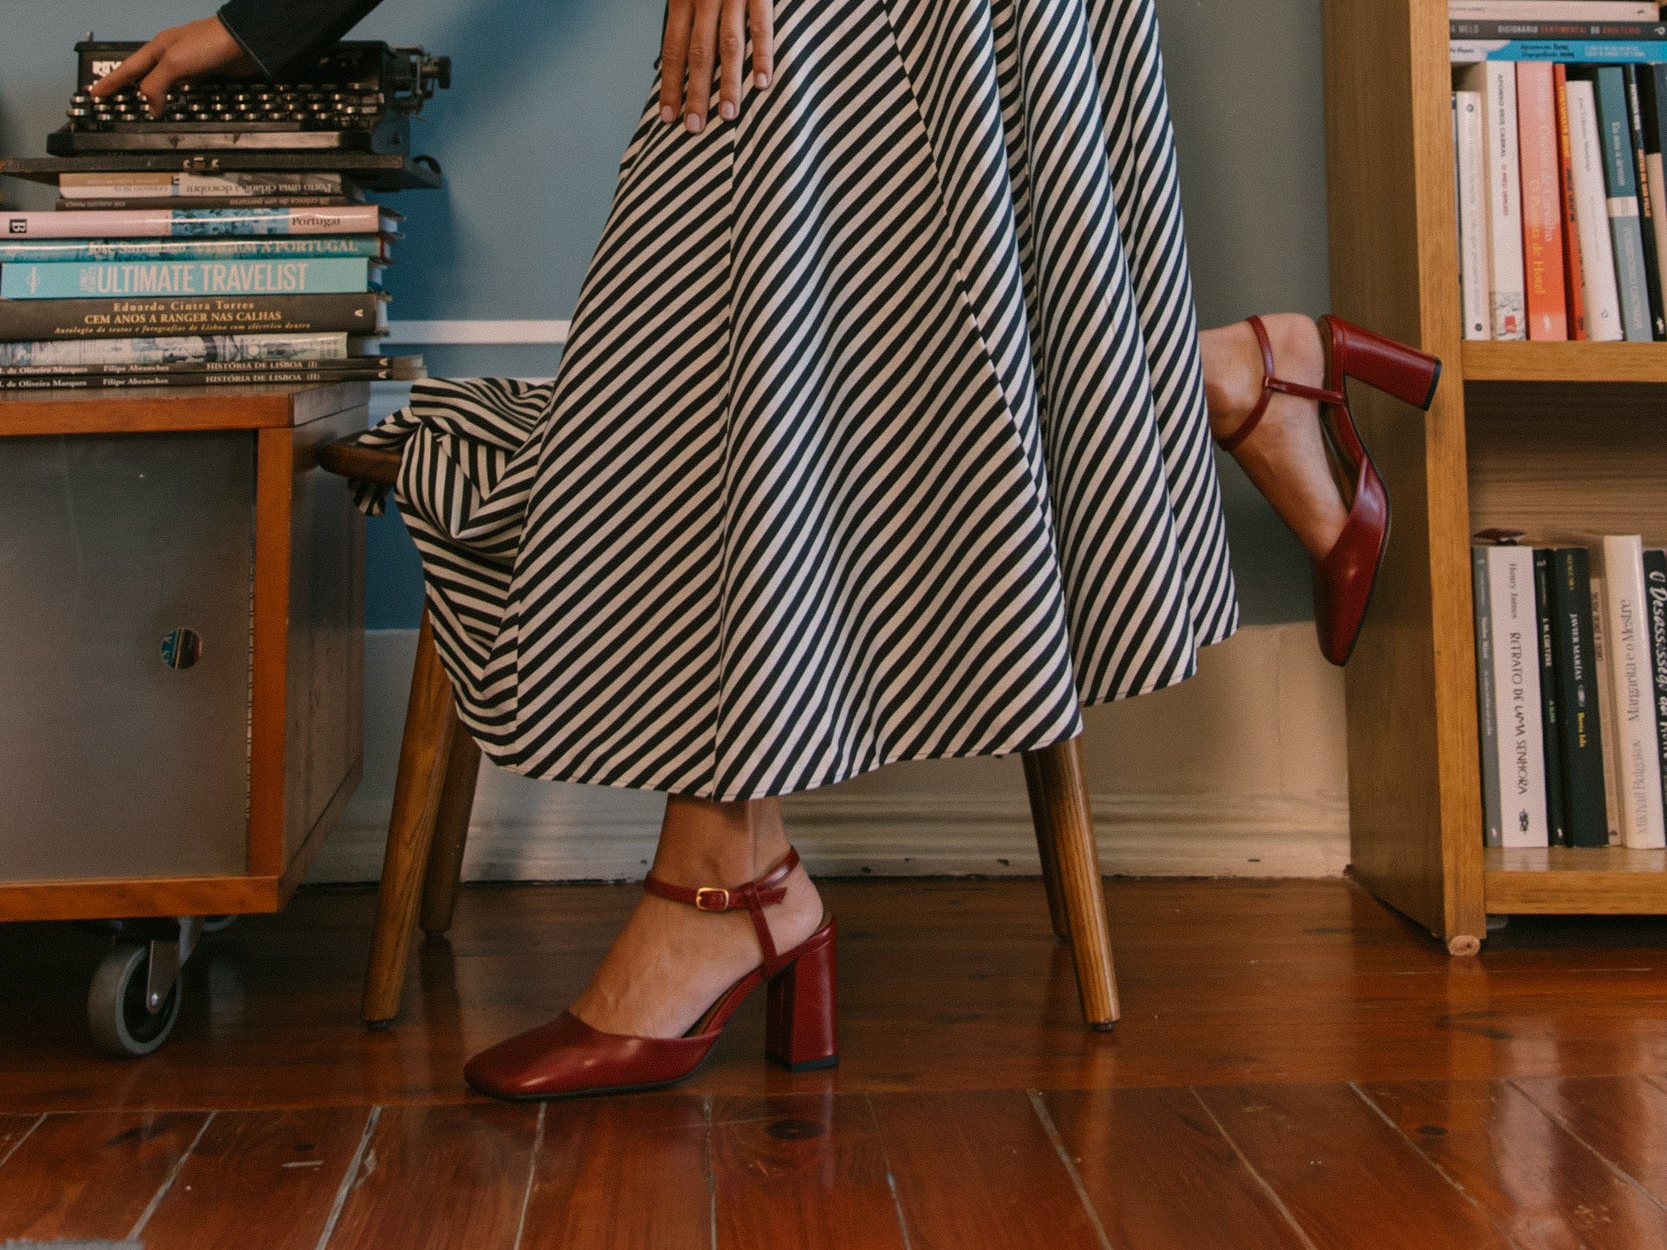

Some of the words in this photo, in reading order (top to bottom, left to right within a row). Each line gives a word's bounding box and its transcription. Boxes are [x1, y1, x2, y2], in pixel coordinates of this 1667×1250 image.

[1497, 74, 1506, 107] AFONSO
[304, 183, 332, 193] Porto
[292, 216, 341, 228] Portugal
[275, 239, 358, 252] PORTUGAL
[97, 265, 195, 293] ULTIMATE
[200, 263, 309, 291] TRAVELIST
[1533, 260, 1546, 294] Hotel
[113, 301, 165, 312] Eduardo
[170, 300, 210, 311] Cintra
[216, 300, 255, 310] Torres
[84, 314, 110, 325] CEM
[114, 313, 146, 324] ANOS
[149, 313, 157, 323] A
[160, 312, 208, 323] RANGER
[211, 311, 233, 322] NAS
[236, 311, 282, 321] CALHAS
[19, 366, 51, 374] Oliveira
[53, 366, 88, 375] Marques
[206, 360, 252, 370] HISTÓRIA
[254, 361, 268, 369] DE
[270, 361, 303, 369] LISBOA
[6, 380, 17, 388] de
[18, 380, 50, 388] Oliveira
[52, 379, 88, 389] Marques
[103, 377, 126, 386] Filipe
[127, 377, 169, 385] Abranches
[206, 373, 251, 383] HISTÓRIA
[253, 374, 267, 382] DE
[269, 374, 302, 382] LISBOA
[1507, 563, 1518, 589] Henry
[1510, 593, 1519, 619] James
[1569, 614, 1581, 643] JAVIER
[1619, 600, 1634, 641] Mestre
[1572, 645, 1585, 680] MARÍAS
[1513, 688, 1524, 701] DE
[1624, 663, 1641, 722] Margarita
[1514, 706, 1526, 736] UMA
[1516, 740, 1529, 795] SENHORA
